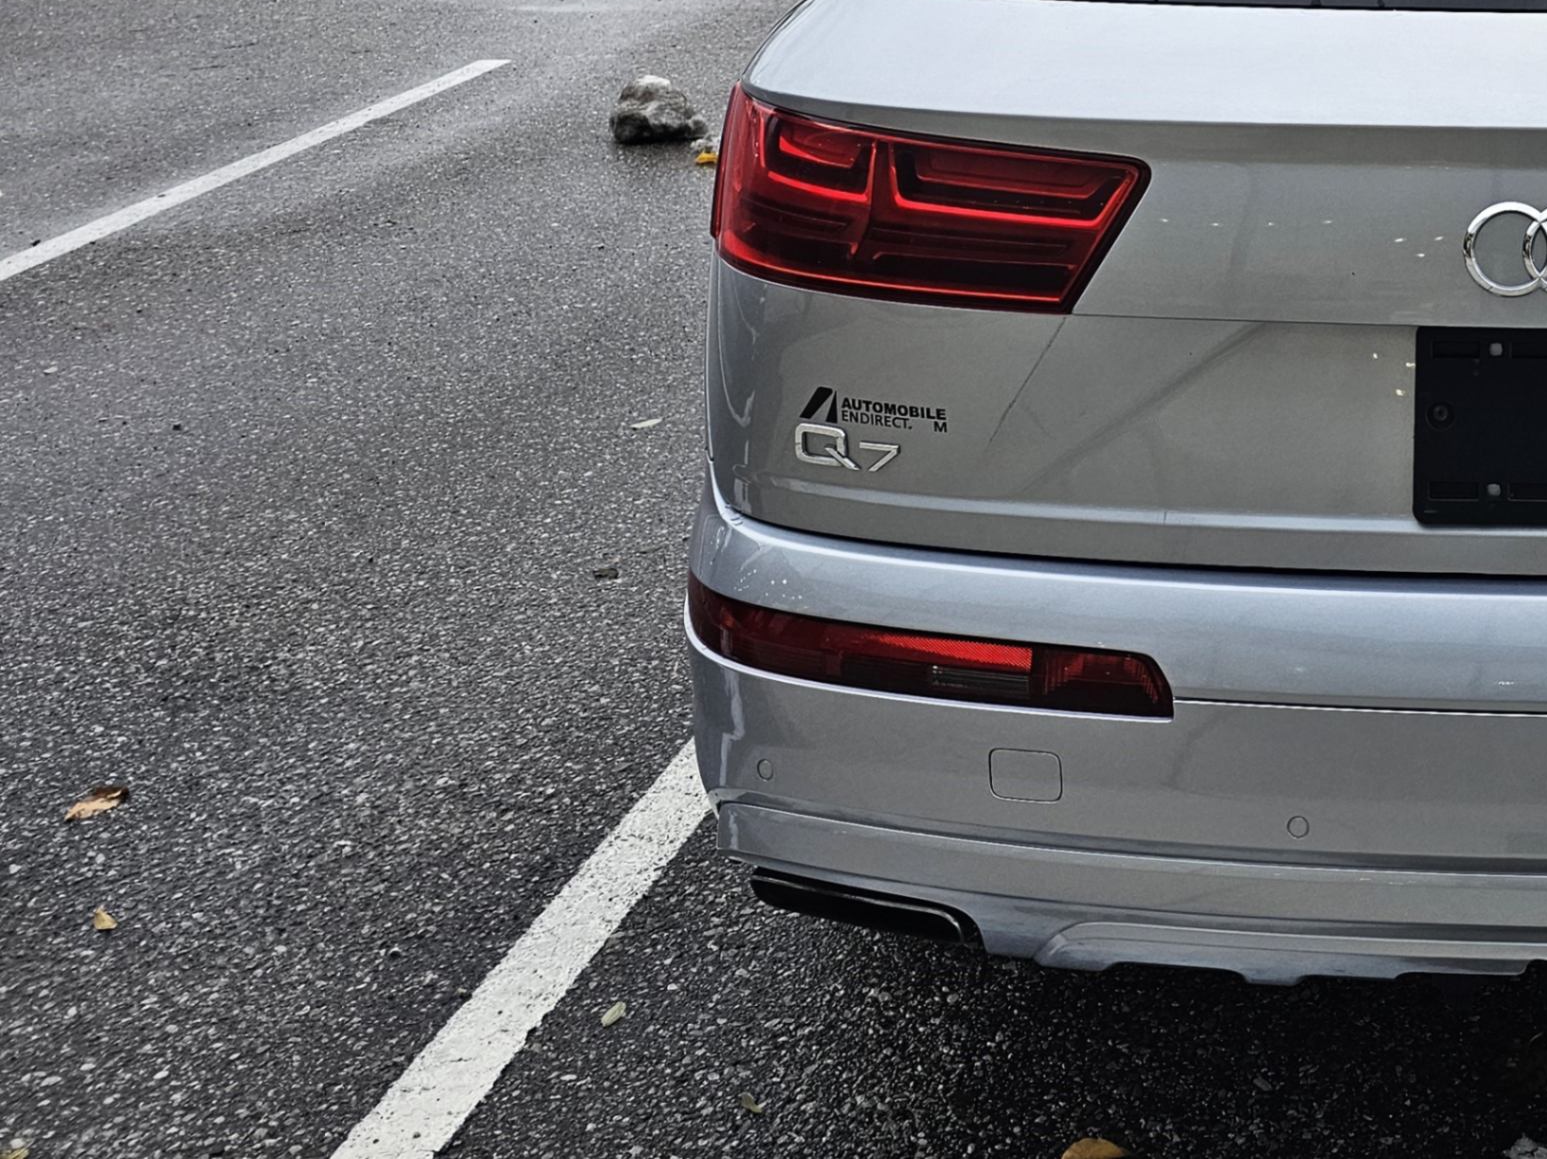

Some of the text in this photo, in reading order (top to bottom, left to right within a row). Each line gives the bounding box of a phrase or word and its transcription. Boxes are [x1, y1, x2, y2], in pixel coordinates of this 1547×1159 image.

[841, 397, 947, 421] AUTOMOBILE
[933, 421, 948, 433] M
[795, 422, 900, 472] Q7
